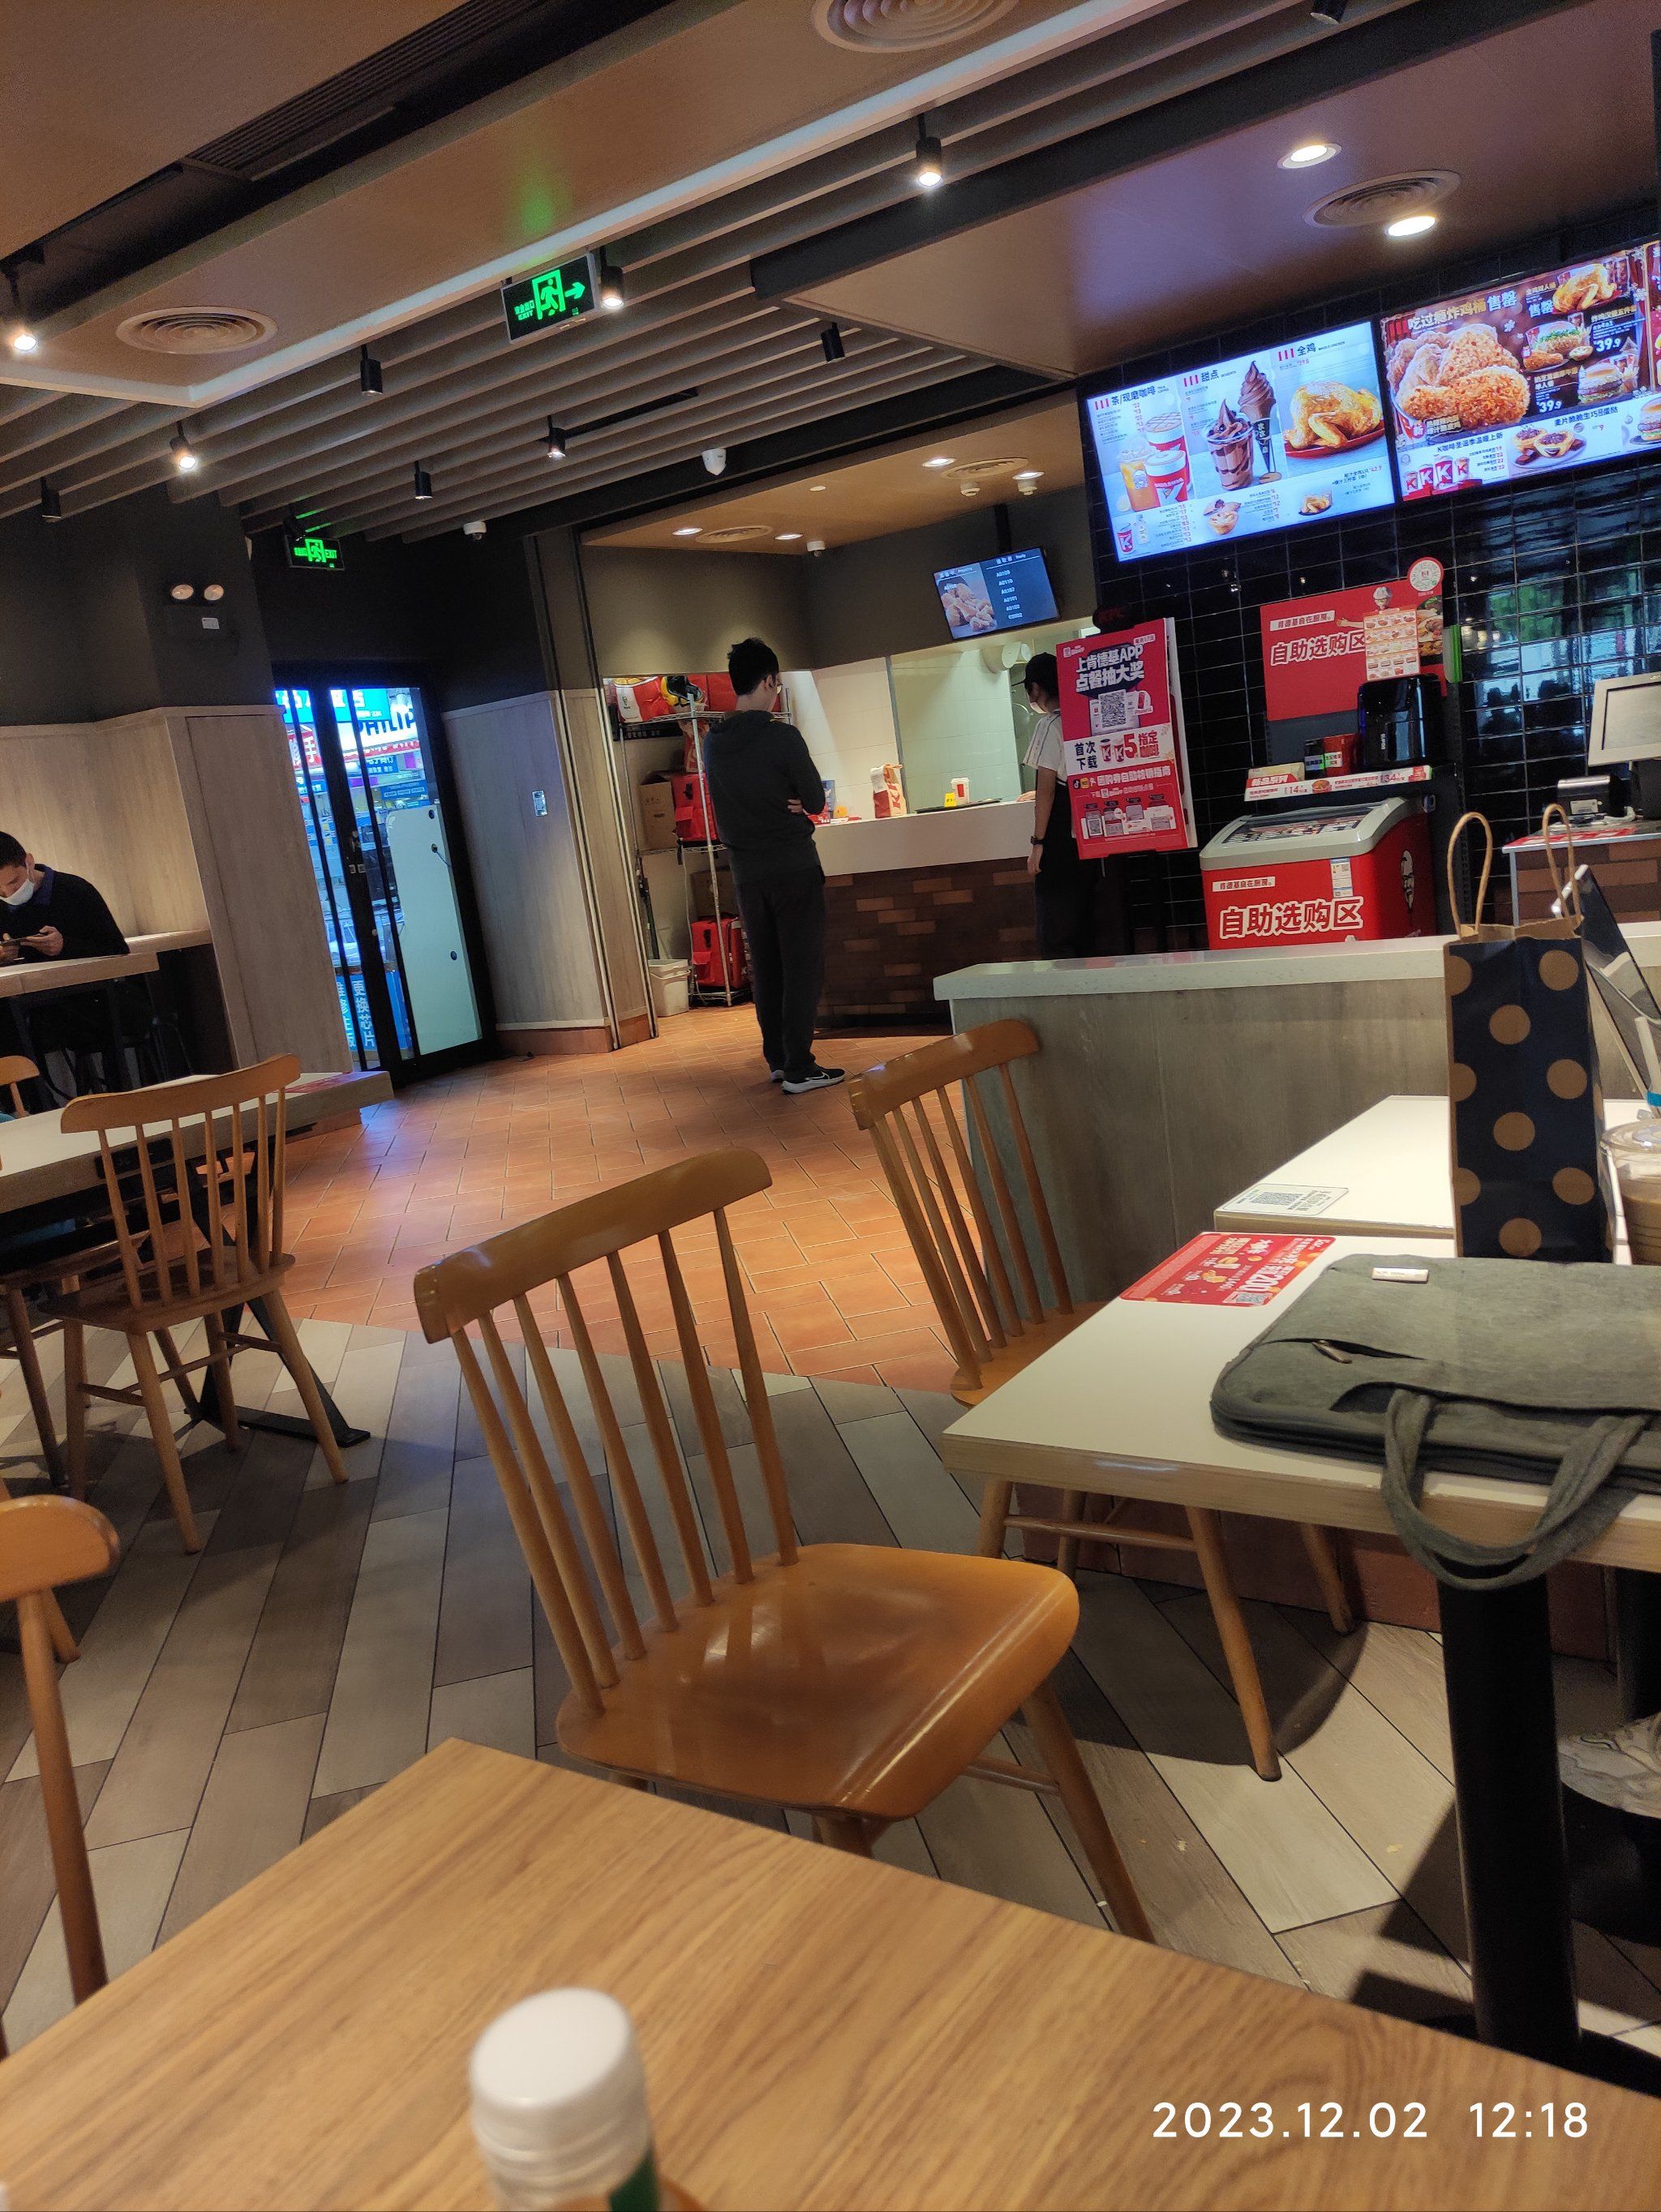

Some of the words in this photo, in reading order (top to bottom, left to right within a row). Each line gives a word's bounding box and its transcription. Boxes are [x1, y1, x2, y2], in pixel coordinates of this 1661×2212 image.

[517, 310, 534, 320] EXIT
[1407, 298, 1487, 330] 吃过瘾炸鸡桶
[1487, 289, 1517, 312] 售罄
[1528, 299, 1554, 318] 售罄
[1297, 342, 1316, 356] 全鸡
[1201, 370, 1219, 383] 甜点
[1270, 629, 1366, 667] 自助选购区
[1075, 644, 1144, 673] 上肯德基APP
[1075, 661, 1145, 692] 点餐抽大奖
[1139, 730, 1158, 745] 指定
[1074, 739, 1096, 757] 首次
[1077, 755, 1098, 770] 下载
[1219, 896, 1364, 940] 自助选购区
